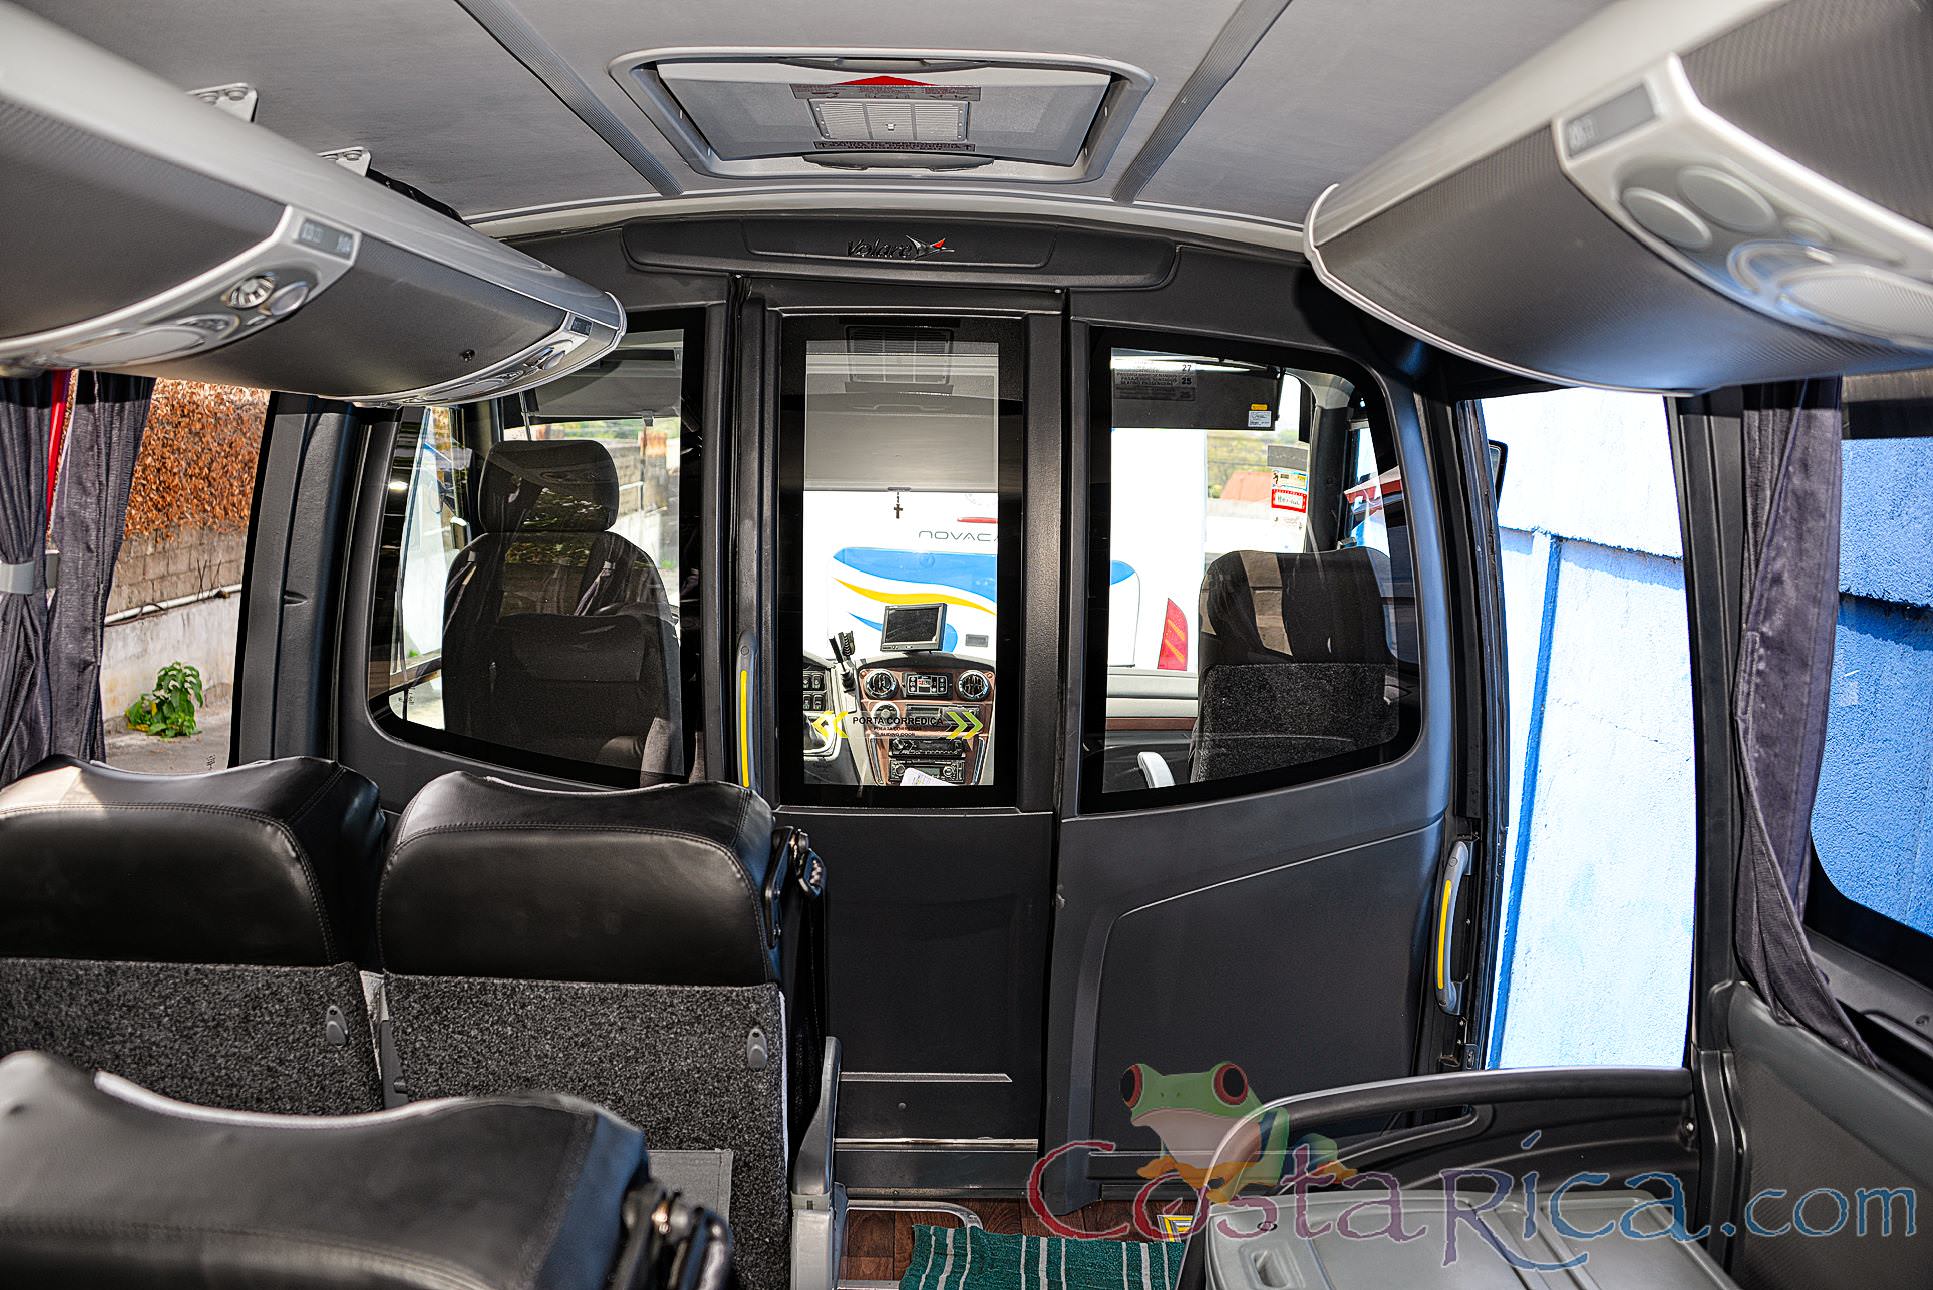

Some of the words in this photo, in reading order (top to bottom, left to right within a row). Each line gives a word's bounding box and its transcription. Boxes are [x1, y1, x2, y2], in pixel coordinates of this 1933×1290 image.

[847, 237, 913, 259] Volare
[1182, 364, 1192, 373] 27
[1181, 377, 1192, 385] 25
[852, 716, 885, 725] PORTA
